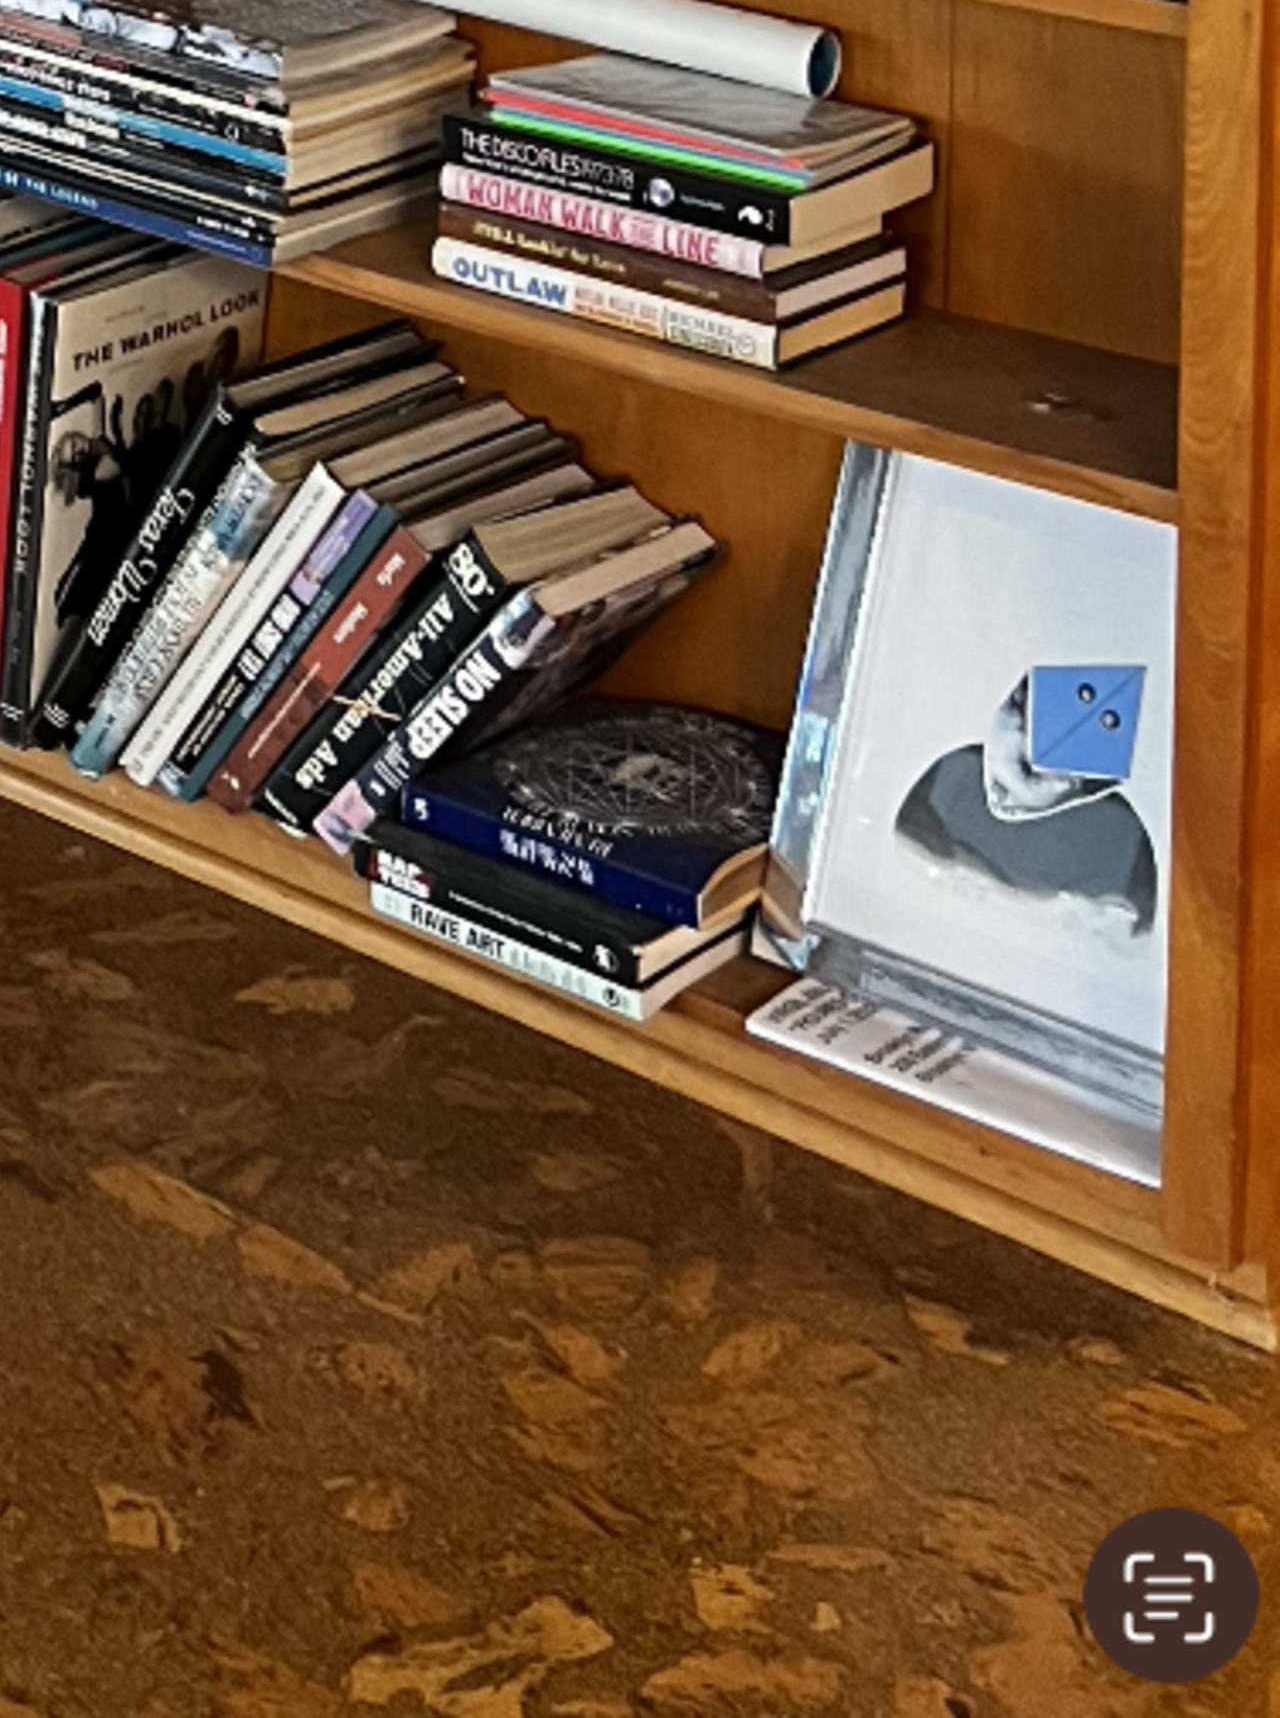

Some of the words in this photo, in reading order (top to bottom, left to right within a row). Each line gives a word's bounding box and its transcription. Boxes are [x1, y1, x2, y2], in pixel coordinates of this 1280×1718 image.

[460, 128, 490, 155] THE
[493, 136, 538, 165] DISCO
[467, 174, 553, 221] WOMAN
[560, 198, 625, 239] WALK
[658, 224, 719, 263] LINE
[452, 256, 567, 306] OUTLAW
[73, 342, 113, 371] THE
[120, 309, 204, 354] WARHOL
[210, 290, 260, 322] LOOK
[138, 486, 196, 555] Texas
[88, 558, 159, 648] Women
[332, 593, 453, 742] All-Amerian
[454, 650, 502, 702] NO
[406, 685, 470, 760] SLEEP
[294, 740, 338, 790] Ads
[410, 904, 460, 939] RAVE
[466, 930, 505, 960] ART
